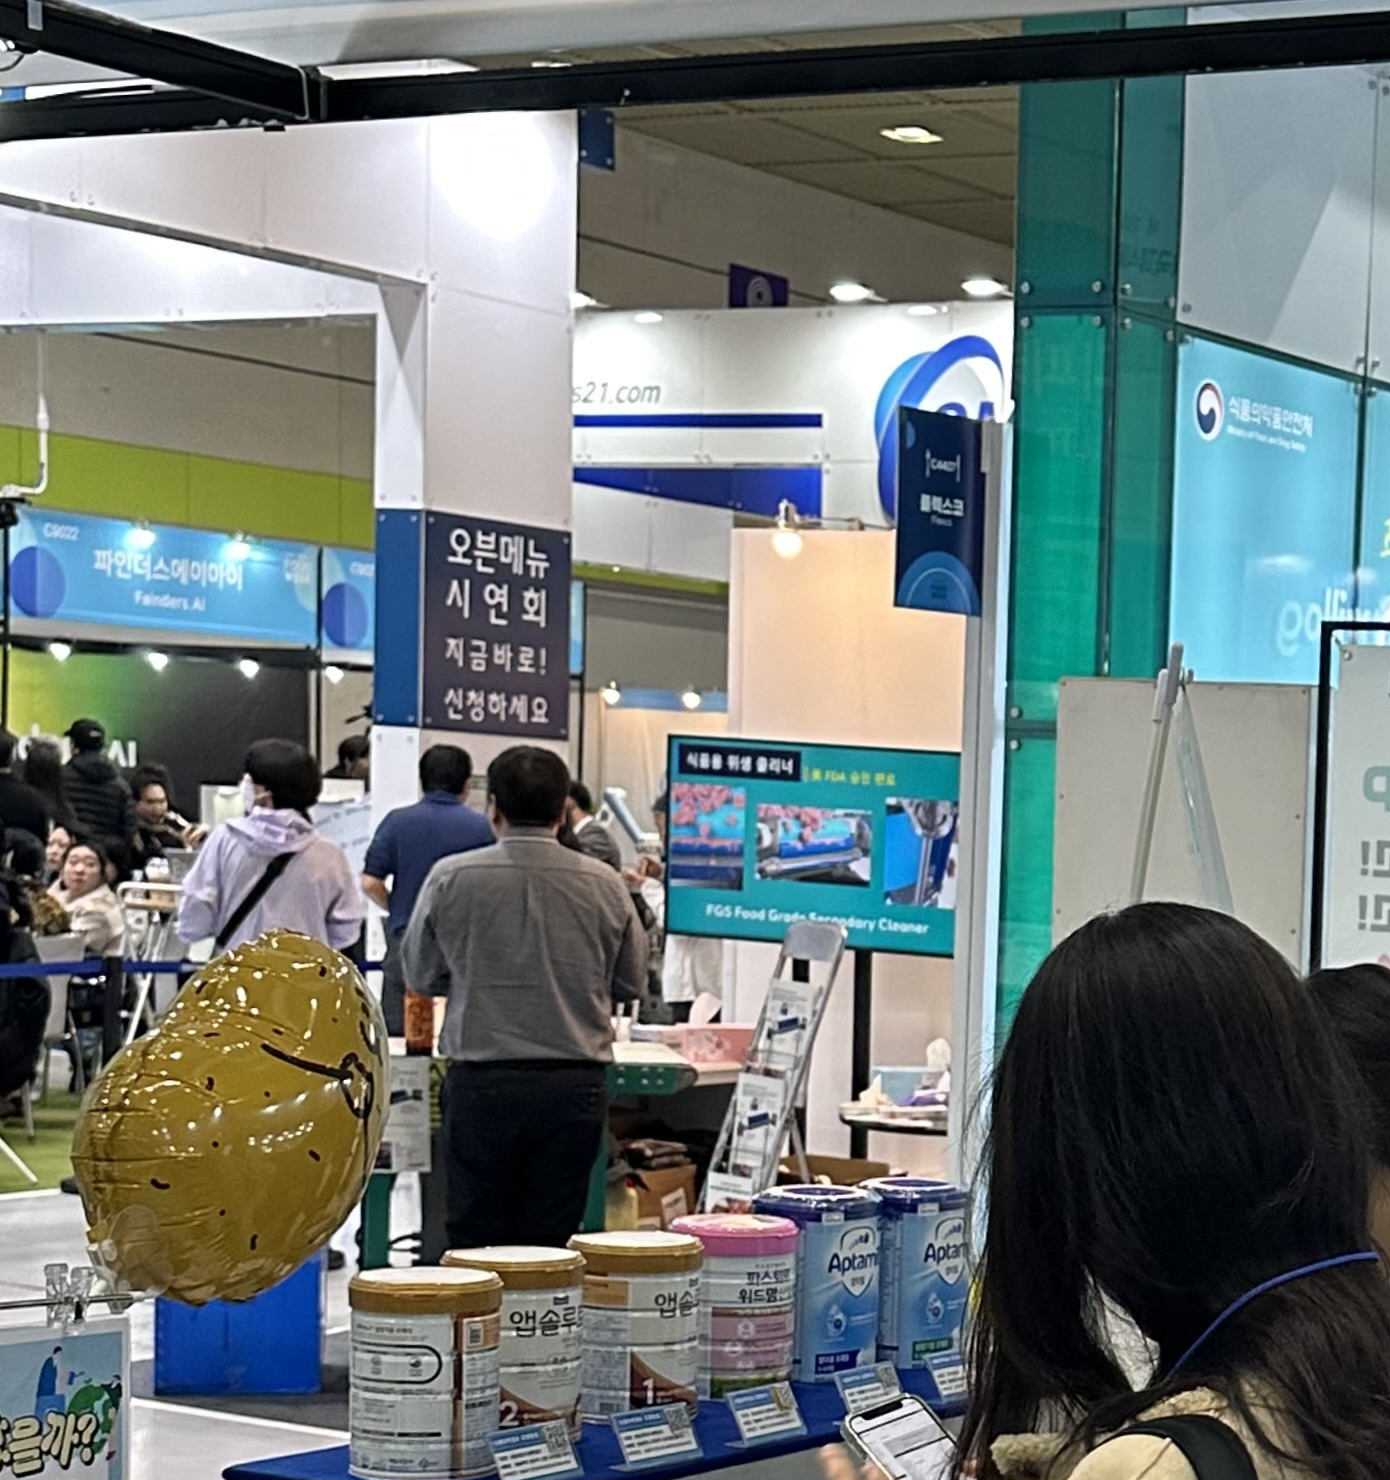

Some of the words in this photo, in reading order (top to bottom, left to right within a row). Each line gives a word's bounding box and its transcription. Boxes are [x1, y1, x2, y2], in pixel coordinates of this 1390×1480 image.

[92, 548, 244, 592] 파인더스에이아이
[446, 528, 550, 579] 오븐메뉴
[444, 637, 547, 675] 지금바로!
[444, 688, 550, 724] 신청하세요
[734, 906, 766, 922] Food
[878, 917, 930, 935] Cleaner
[499, 1401, 520, 1427] 2
